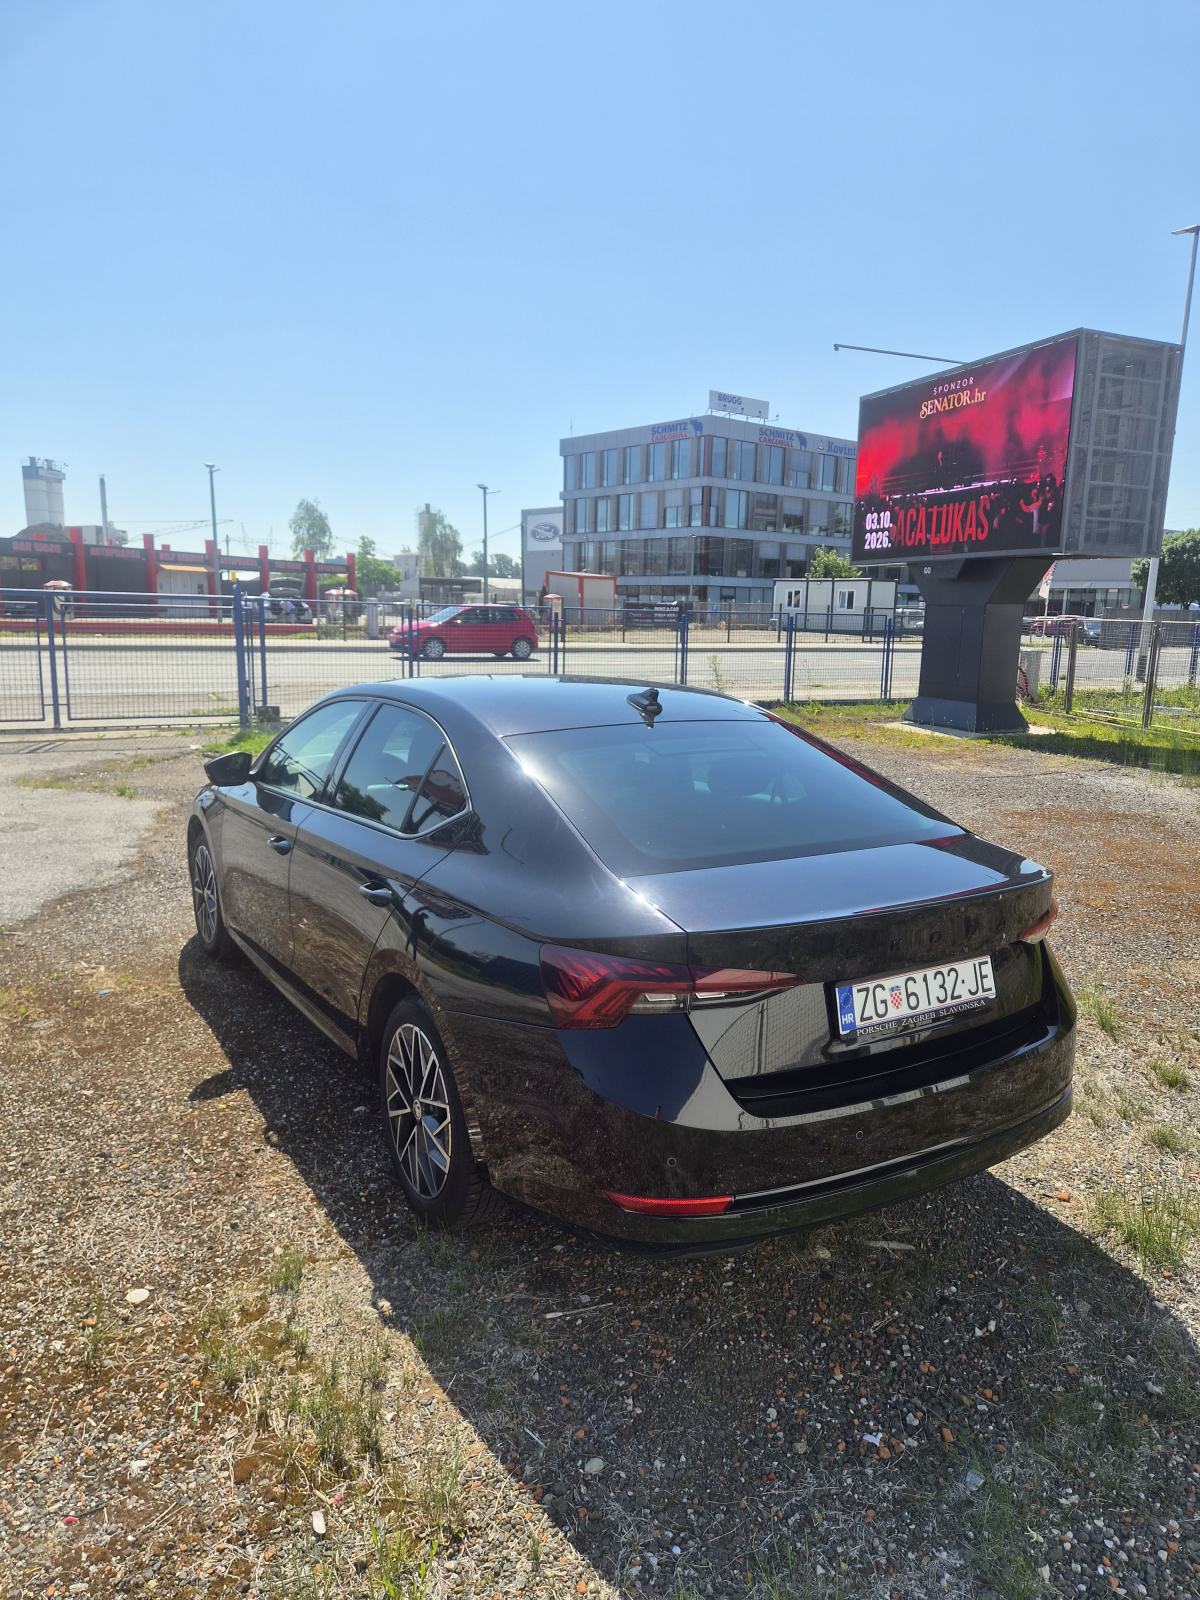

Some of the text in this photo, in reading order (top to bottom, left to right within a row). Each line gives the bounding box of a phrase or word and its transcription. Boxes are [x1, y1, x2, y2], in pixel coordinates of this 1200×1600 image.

[933, 377, 974, 395] SPONZOR
[717, 391, 743, 405] BRUGG
[920, 388, 986, 419] SENATOR.hr
[651, 421, 688, 435] SCHMITZ
[760, 427, 794, 442] SCHMITZ
[865, 511, 893, 530] 03.10.
[930, 495, 989, 545] LUKAS
[864, 531, 892, 549] 2026.
[857, 984, 889, 1023] ZG
[841, 1013, 855, 1026] HR
[857, 998, 987, 1037] PORSCHE ZAGREB SLAVONSKA
